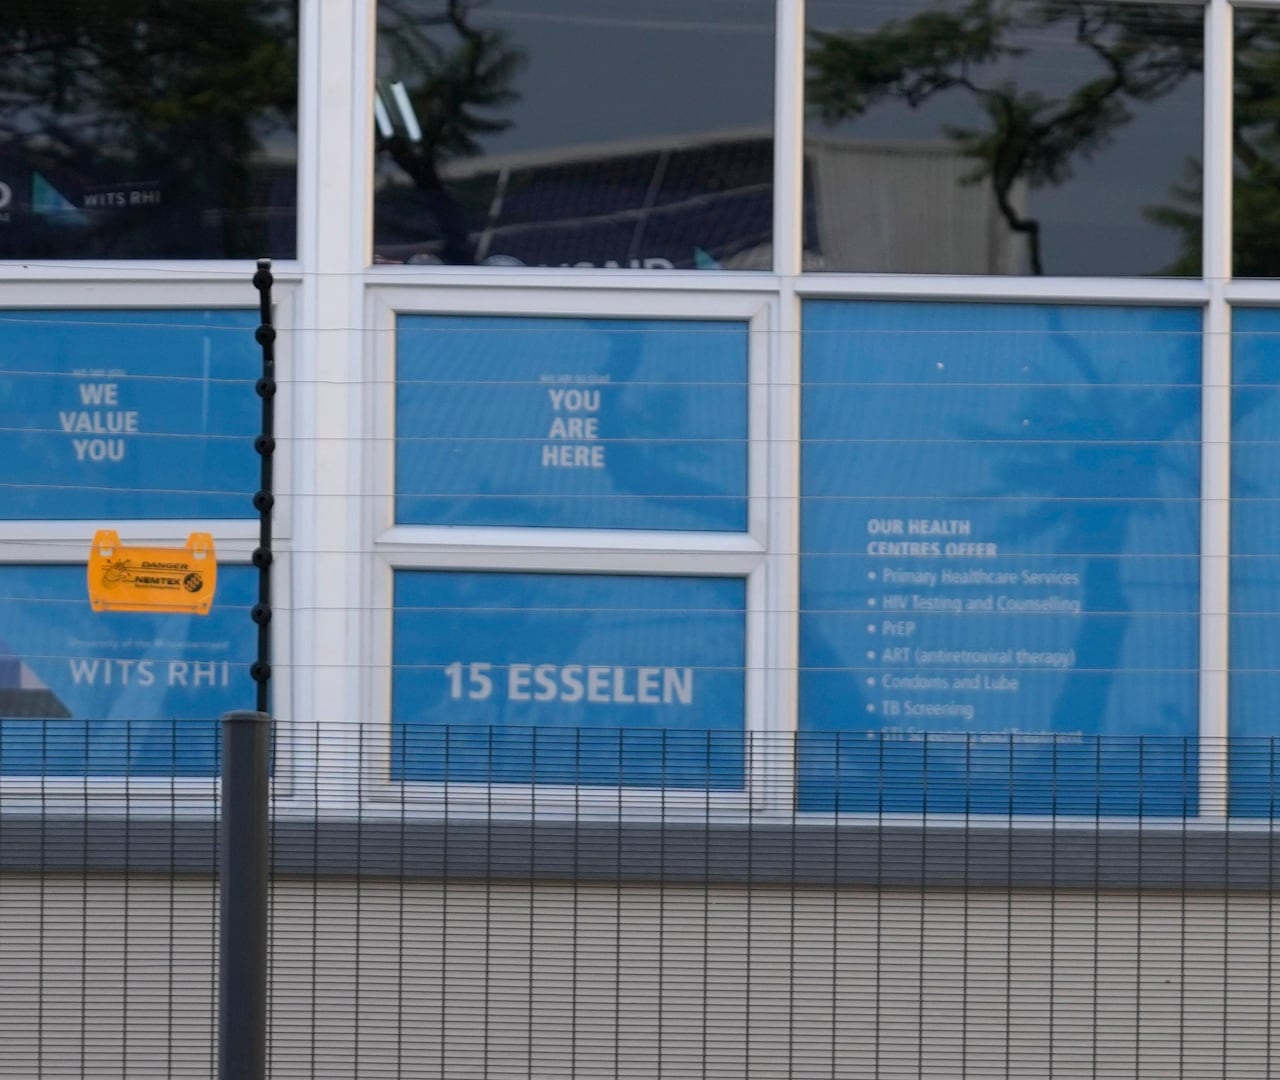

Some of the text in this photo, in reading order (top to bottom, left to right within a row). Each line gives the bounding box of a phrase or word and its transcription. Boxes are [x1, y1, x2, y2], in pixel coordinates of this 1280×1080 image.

[83, 190, 161, 208] WITS RHI
[79, 383, 118, 405] WE
[548, 389, 600, 412] YOU
[59, 411, 138, 434] VALUE
[548, 417, 599, 440] ARE
[72, 438, 125, 462] YOU
[542, 445, 605, 468] HERE
[867, 518, 971, 536] OUR HEALTH
[867, 541, 998, 558] CENTRES OFFER
[141, 561, 189, 570] DANGER
[134, 576, 181, 585] NEMTEK
[882, 567, 1079, 587] Primary Healthcare Services
[883, 594, 1080, 615] HIV Testing and Counselling
[882, 621, 916, 636] PrEP
[881, 648, 911, 663] ART
[1016, 648, 1076, 668] therapy)
[69, 658, 230, 687] WITS RHI
[881, 674, 1018, 690] Condoms and Lube
[443, 661, 693, 706] 15 ESSELEN
[882, 700, 974, 720] TB Screening
